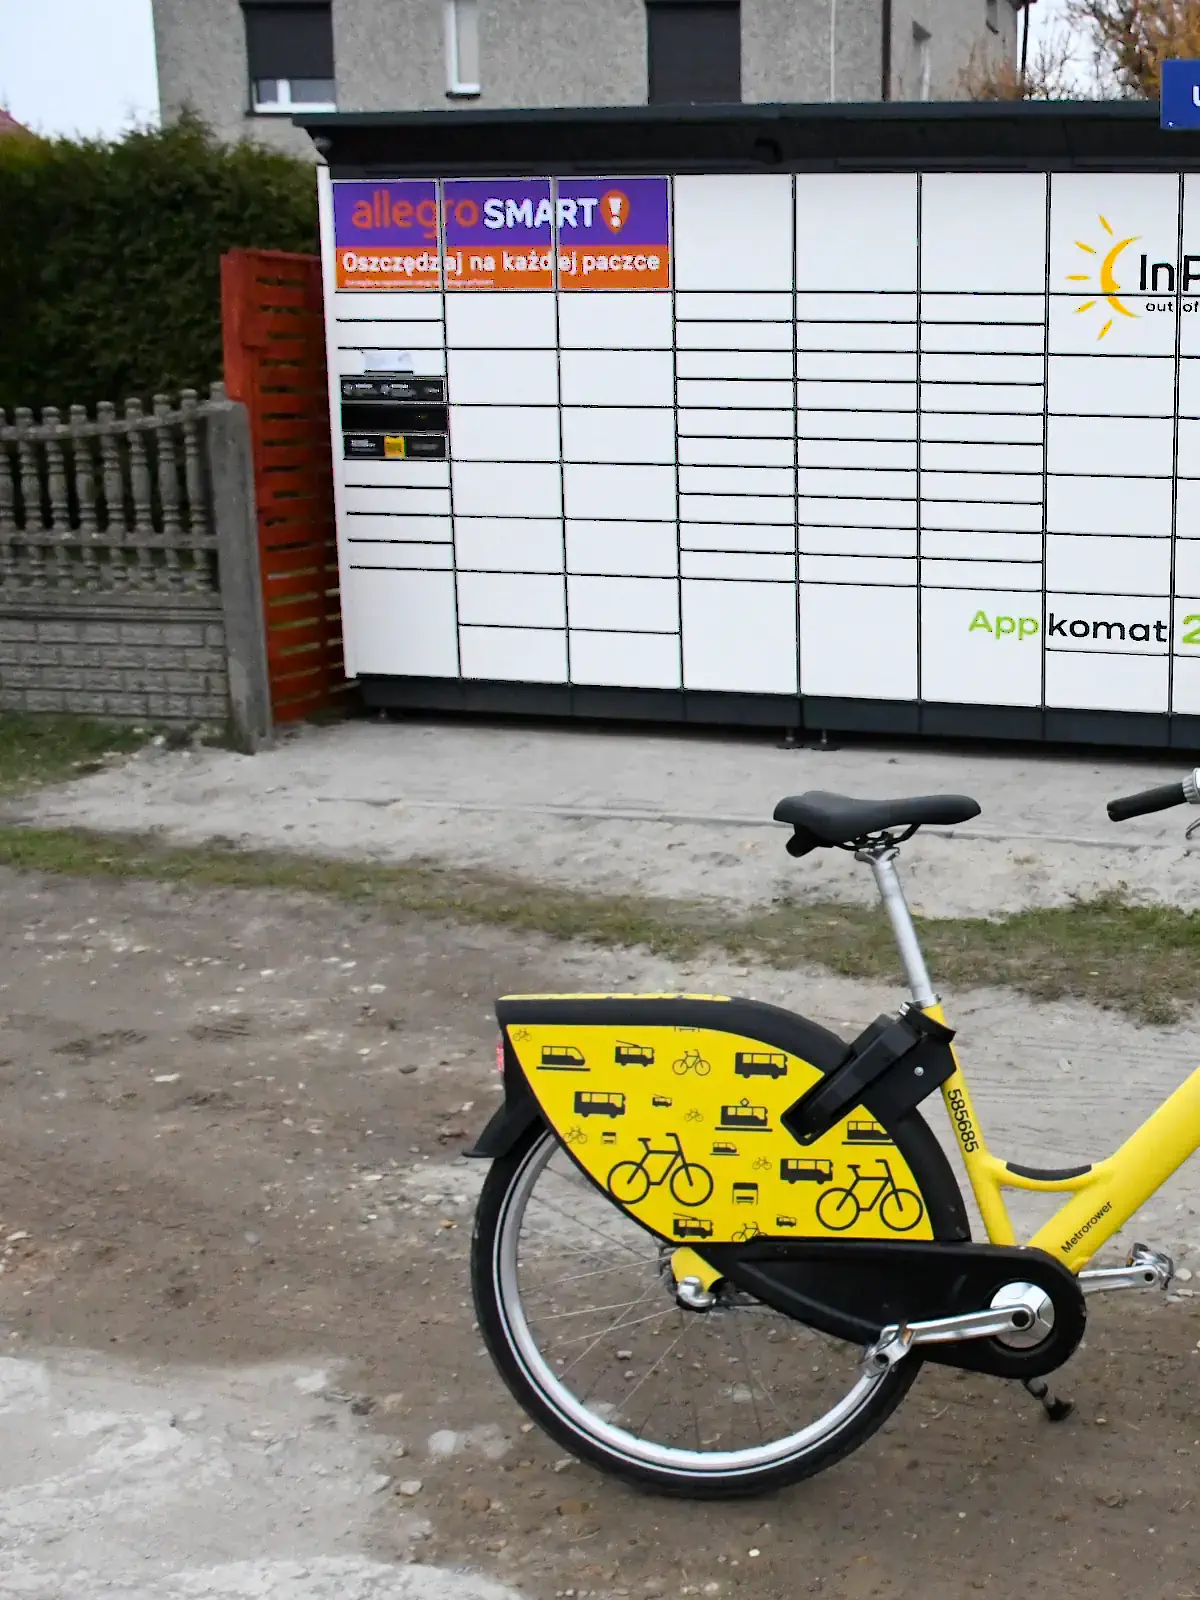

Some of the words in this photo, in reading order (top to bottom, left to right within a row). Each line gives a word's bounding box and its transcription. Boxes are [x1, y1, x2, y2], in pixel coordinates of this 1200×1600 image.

[470, 255, 497, 273] na
[502, 248, 577, 276] każdej
[582, 254, 660, 275] paczce
[1145, 302, 1174, 313] out
[1182, 301, 1199, 314] of
[947, 1088, 980, 1154] 585685
[1060, 1200, 1113, 1254] Metrorower
